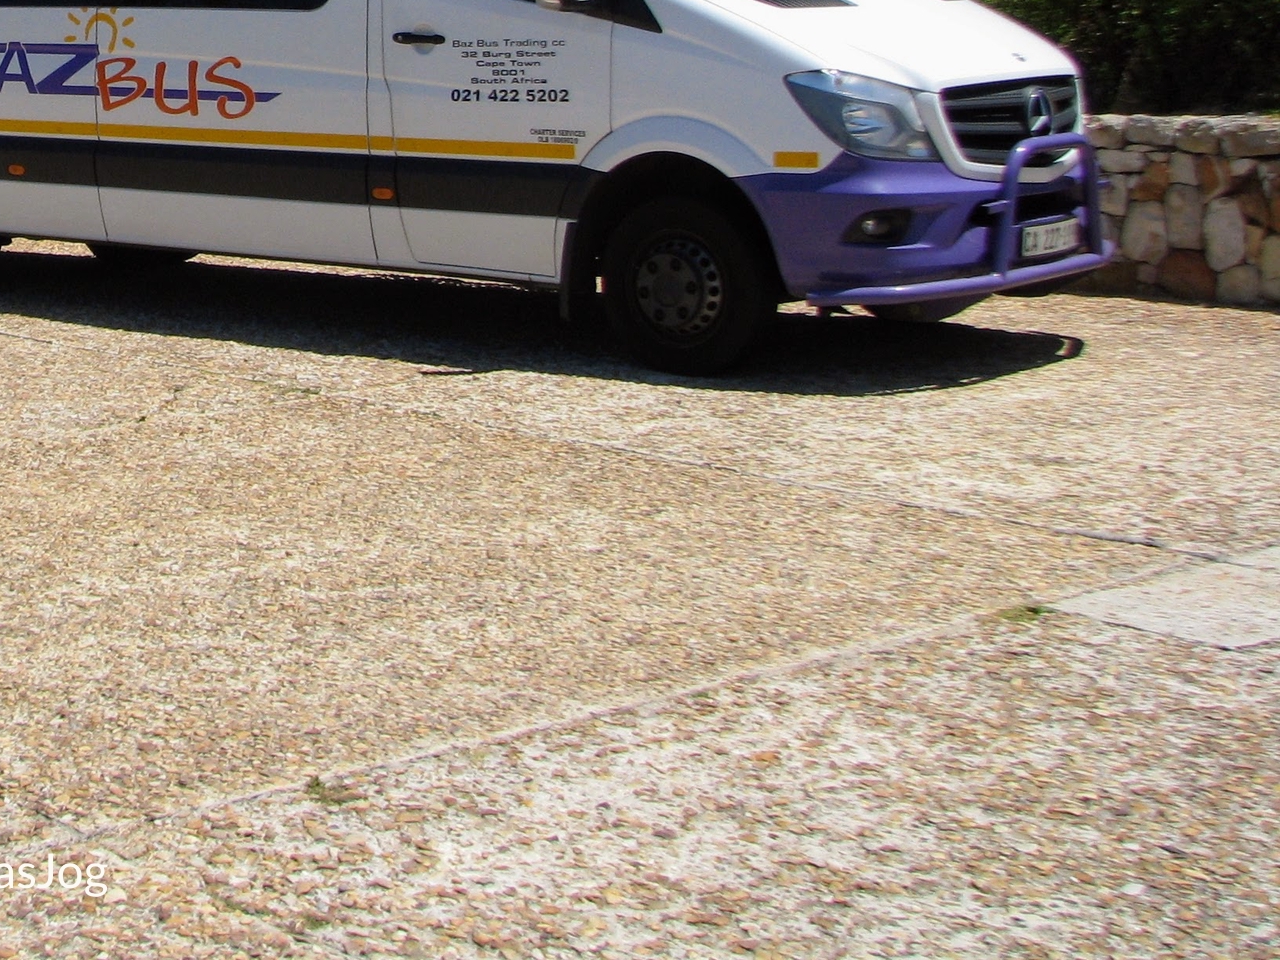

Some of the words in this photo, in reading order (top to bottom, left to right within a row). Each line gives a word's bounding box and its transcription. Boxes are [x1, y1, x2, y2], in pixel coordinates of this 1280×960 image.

[452, 39, 473, 48] Baz
[476, 39, 499, 48] Bus
[502, 38, 547, 49] Trading
[482, 51, 512, 59] Burg
[516, 50, 556, 58] Street
[476, 60, 505, 68] Cape
[492, 69, 525, 77] 8001
[471, 77, 507, 85] South
[512, 77, 548, 85] Africa
[96, 56, 256, 120] BUS
[451, 89, 480, 102] 021
[488, 89, 520, 102] 422
[526, 89, 569, 102] 5202
